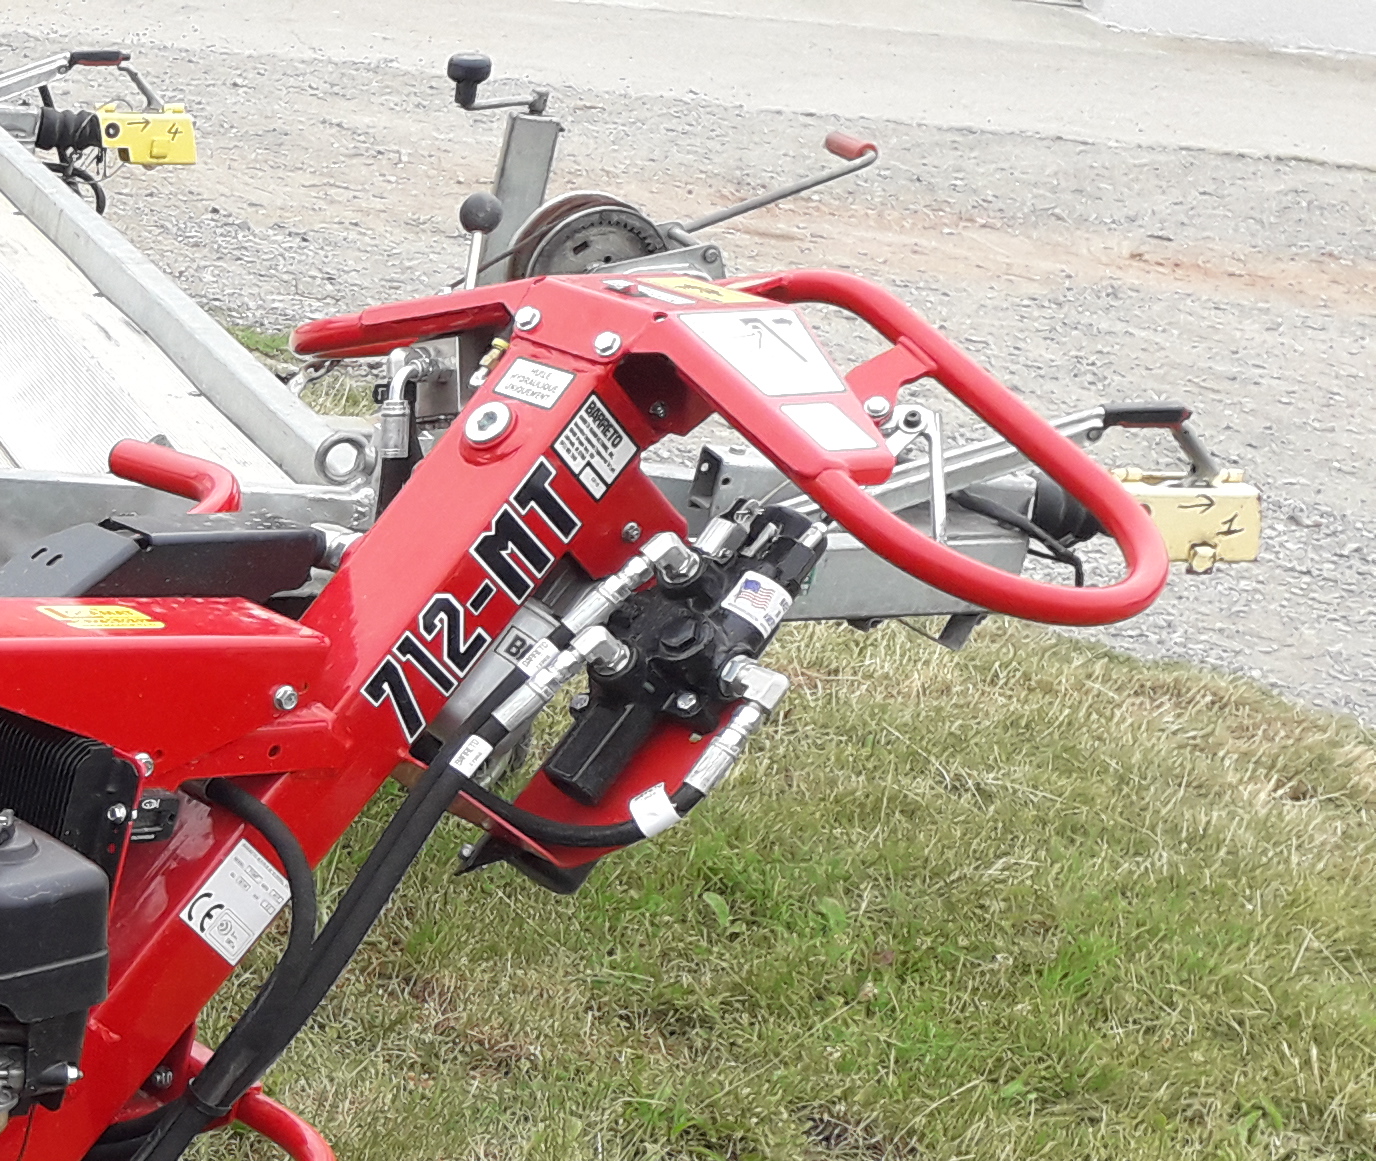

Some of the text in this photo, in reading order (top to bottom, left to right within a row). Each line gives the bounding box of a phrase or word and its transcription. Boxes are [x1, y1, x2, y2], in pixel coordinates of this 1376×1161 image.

[167, 122, 184, 142] 4
[584, 399, 624, 450] BARRETO
[360, 455, 583, 744] 712-MT
